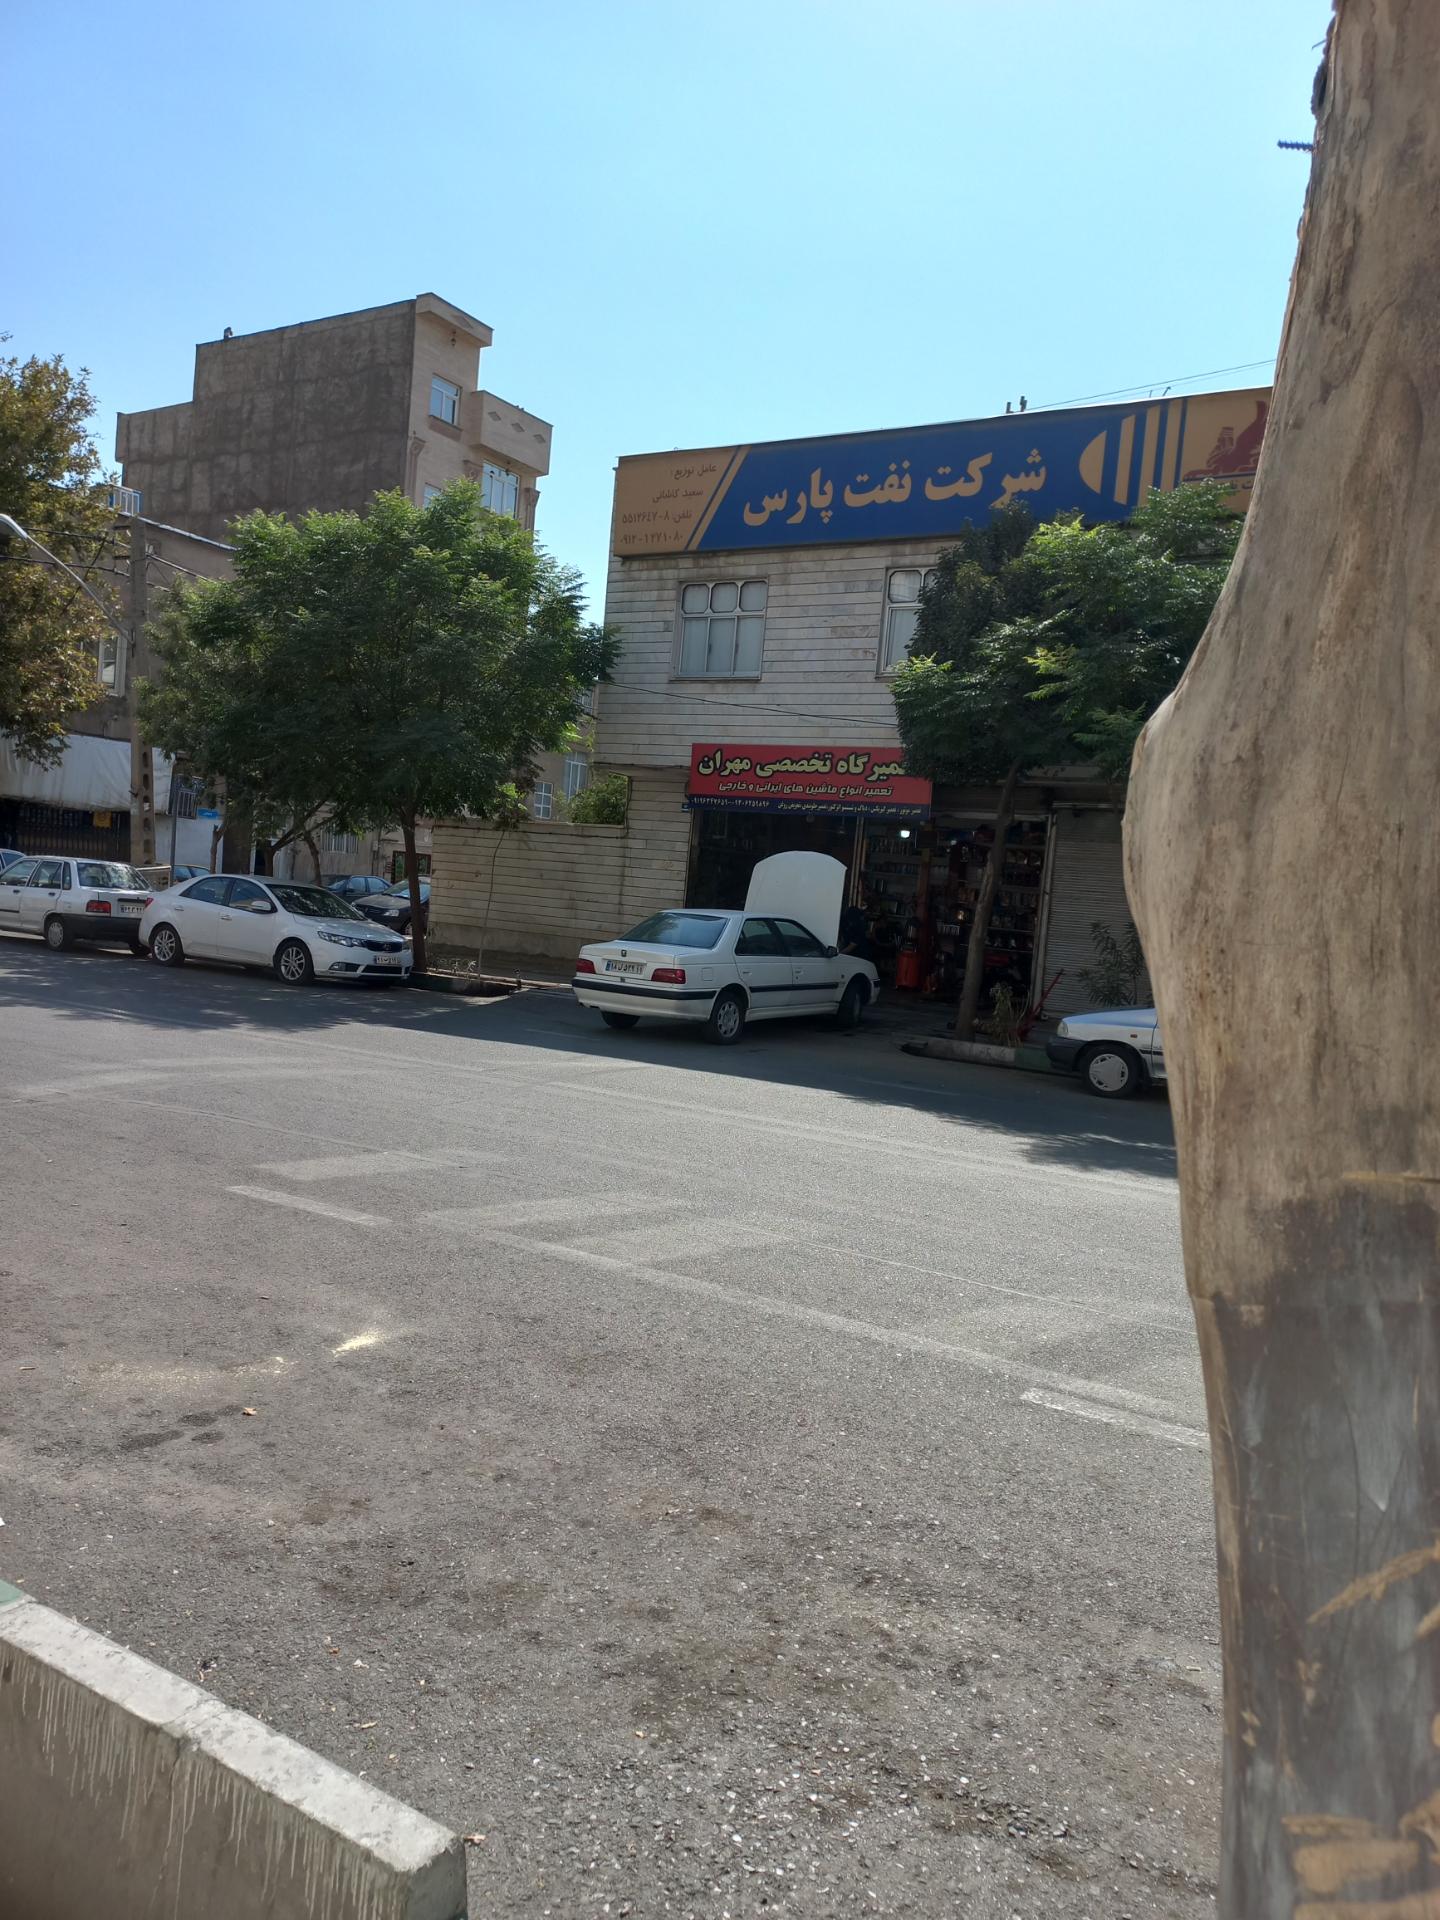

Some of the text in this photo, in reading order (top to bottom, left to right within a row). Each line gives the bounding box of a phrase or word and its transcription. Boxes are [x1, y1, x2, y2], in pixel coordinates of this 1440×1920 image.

[697, 464, 717, 477] عامل
[682, 488, 703, 497] سعید
[743, 448, 1047, 527] شرکت نفت پارس
[698, 749, 752, 776] مهران
[755, 753, 832, 777] تخصصی
[719, 781, 747, 791] خارجی
[755, 782, 782, 792] ایرانی
[783, 783, 804, 794] های
[806, 783, 838, 796] ماشین
[840, 785, 865, 798] انواع
[864, 787, 893, 798] تعمیر
